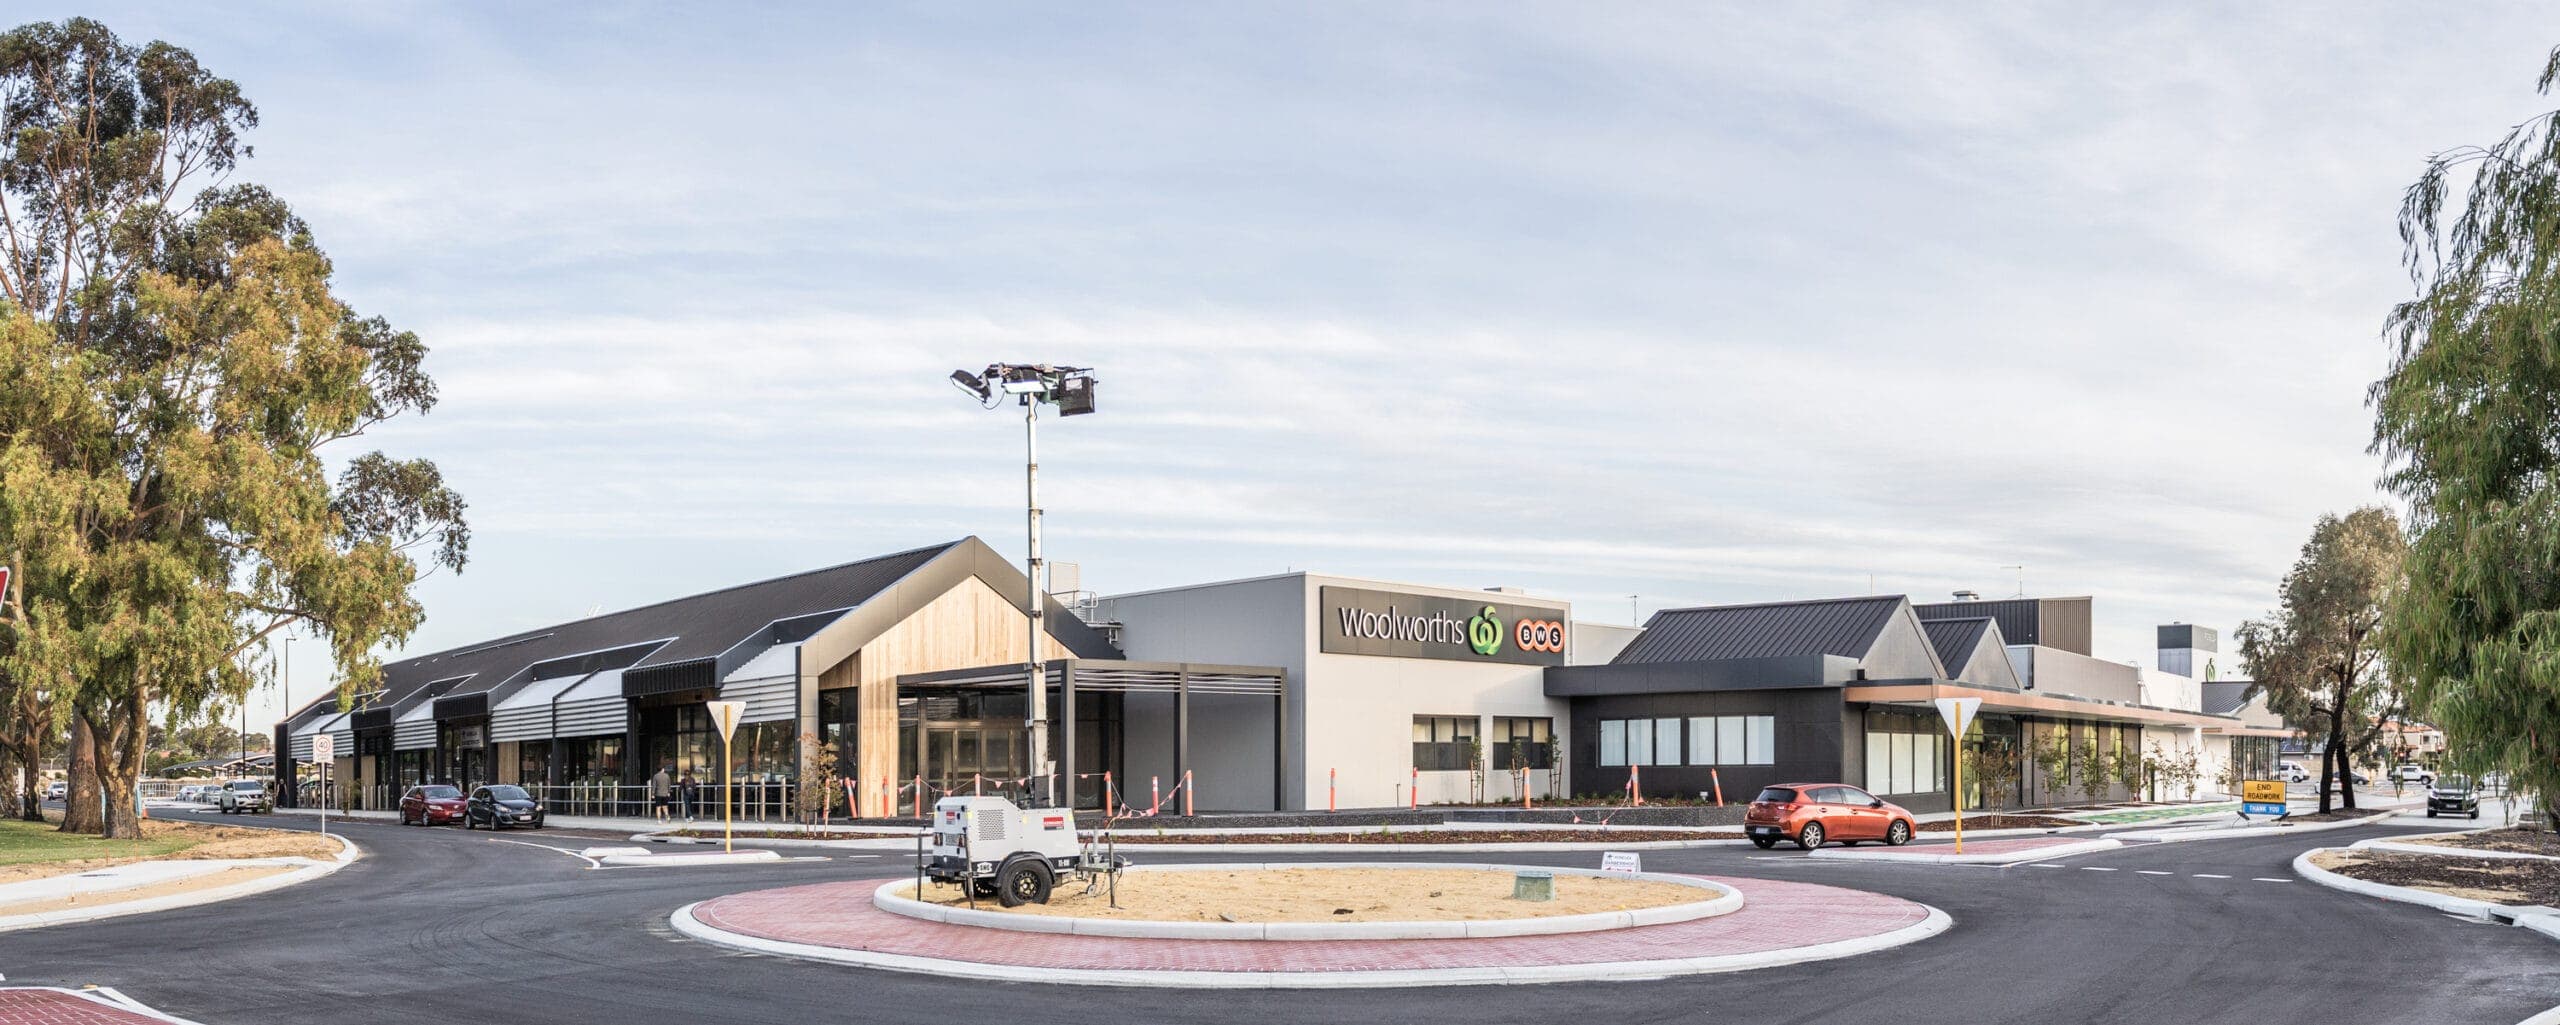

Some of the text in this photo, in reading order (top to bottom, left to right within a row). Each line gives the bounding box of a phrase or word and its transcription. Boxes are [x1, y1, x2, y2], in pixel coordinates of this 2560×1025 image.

[1338, 605, 1464, 645] Woolworths
[1521, 624, 1560, 645] BWS
[318, 740, 328, 749] 40
[2247, 792, 2280, 800] ROADWORK
[2249, 804, 2267, 812] THANK
